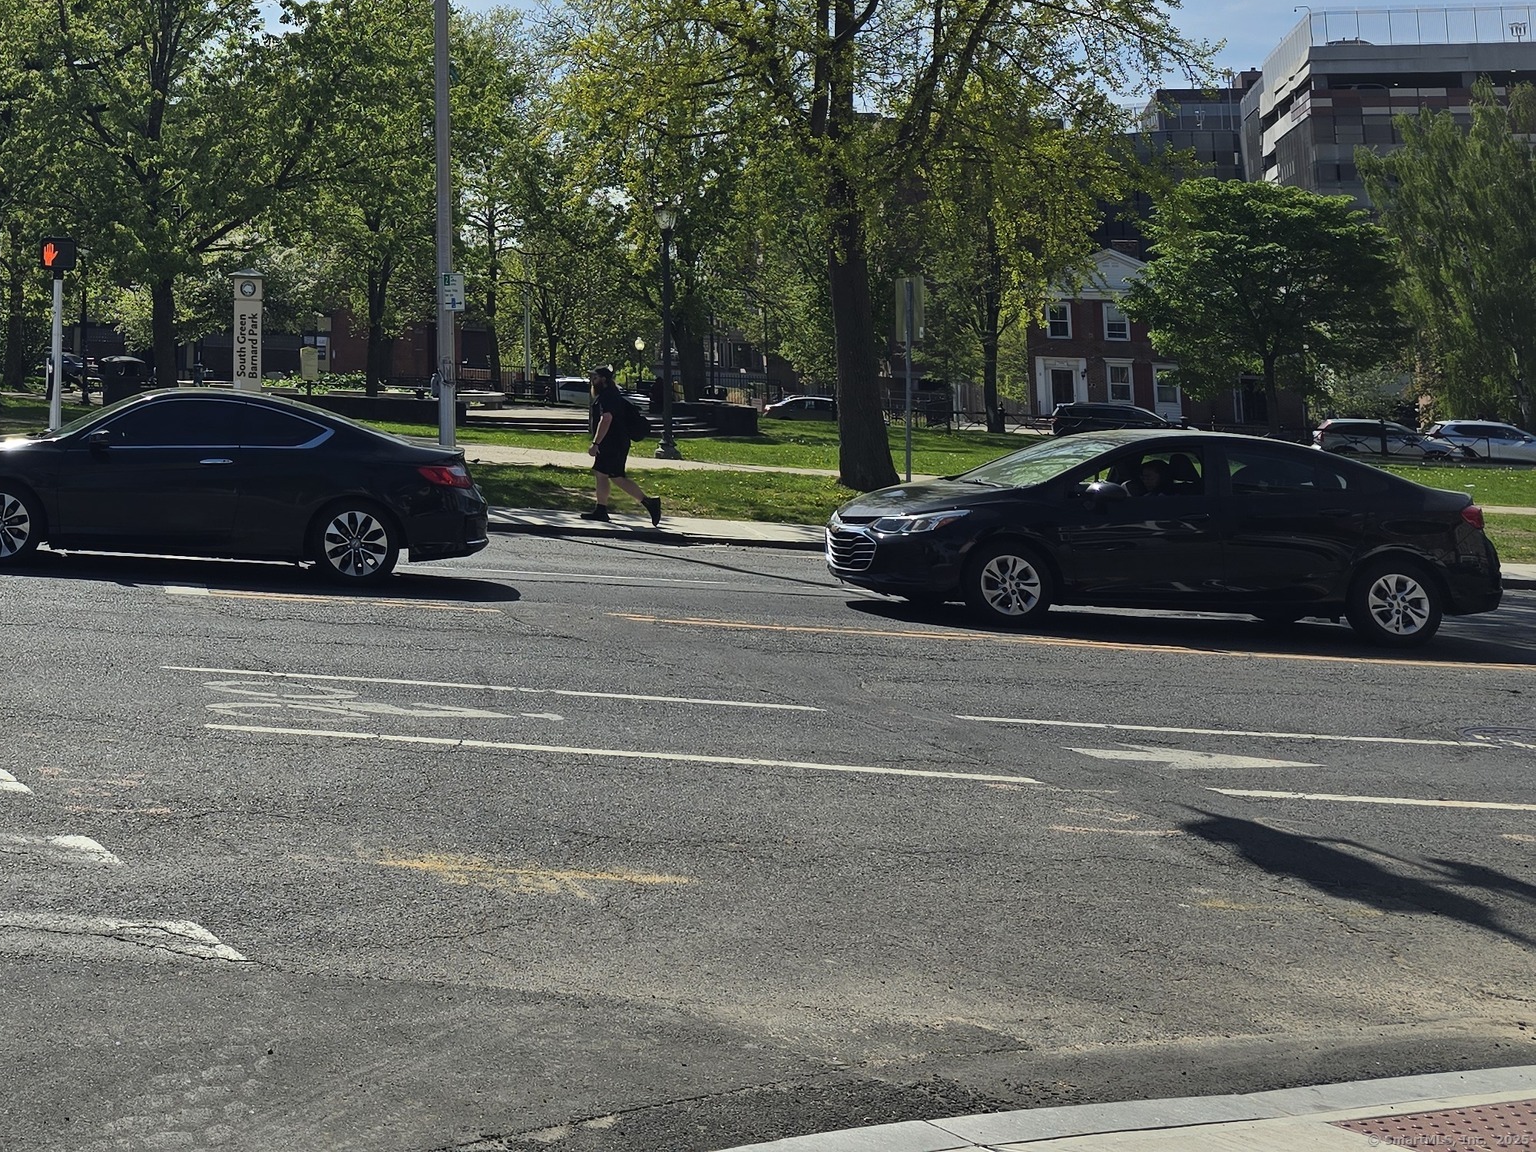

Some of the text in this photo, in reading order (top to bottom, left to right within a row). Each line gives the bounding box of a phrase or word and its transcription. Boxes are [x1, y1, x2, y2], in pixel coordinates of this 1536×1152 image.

[237, 314, 246, 378] South Green
[248, 313, 258, 379] Barnard Park
